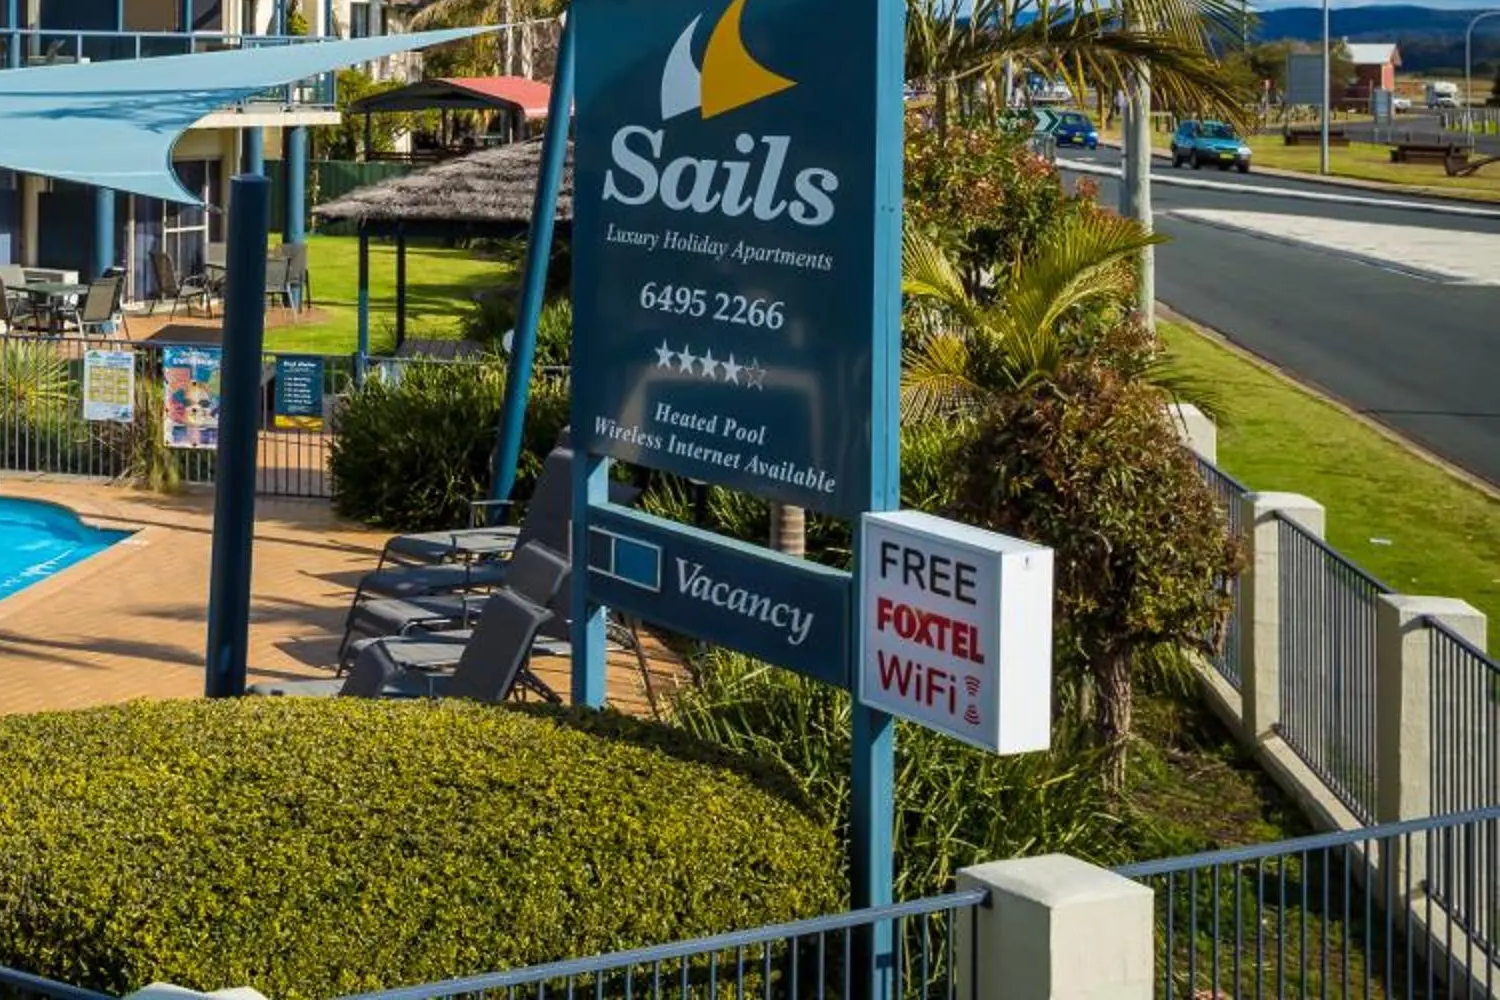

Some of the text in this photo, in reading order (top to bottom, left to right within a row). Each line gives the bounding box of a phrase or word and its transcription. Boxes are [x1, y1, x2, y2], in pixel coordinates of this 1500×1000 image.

[603, 125, 839, 226] Sails
[606, 223, 834, 271] Luxury Holiday Apartments
[640, 281, 785, 329] 6495 2266
[595, 416, 837, 493] Wireless Internet Available
[655, 402, 767, 445] Heated Pool
[675, 557, 814, 645] Vacancy
[880, 541, 977, 605] FREE
[877, 599, 984, 663] FOXTEL
[878, 649, 956, 715] WiFi
